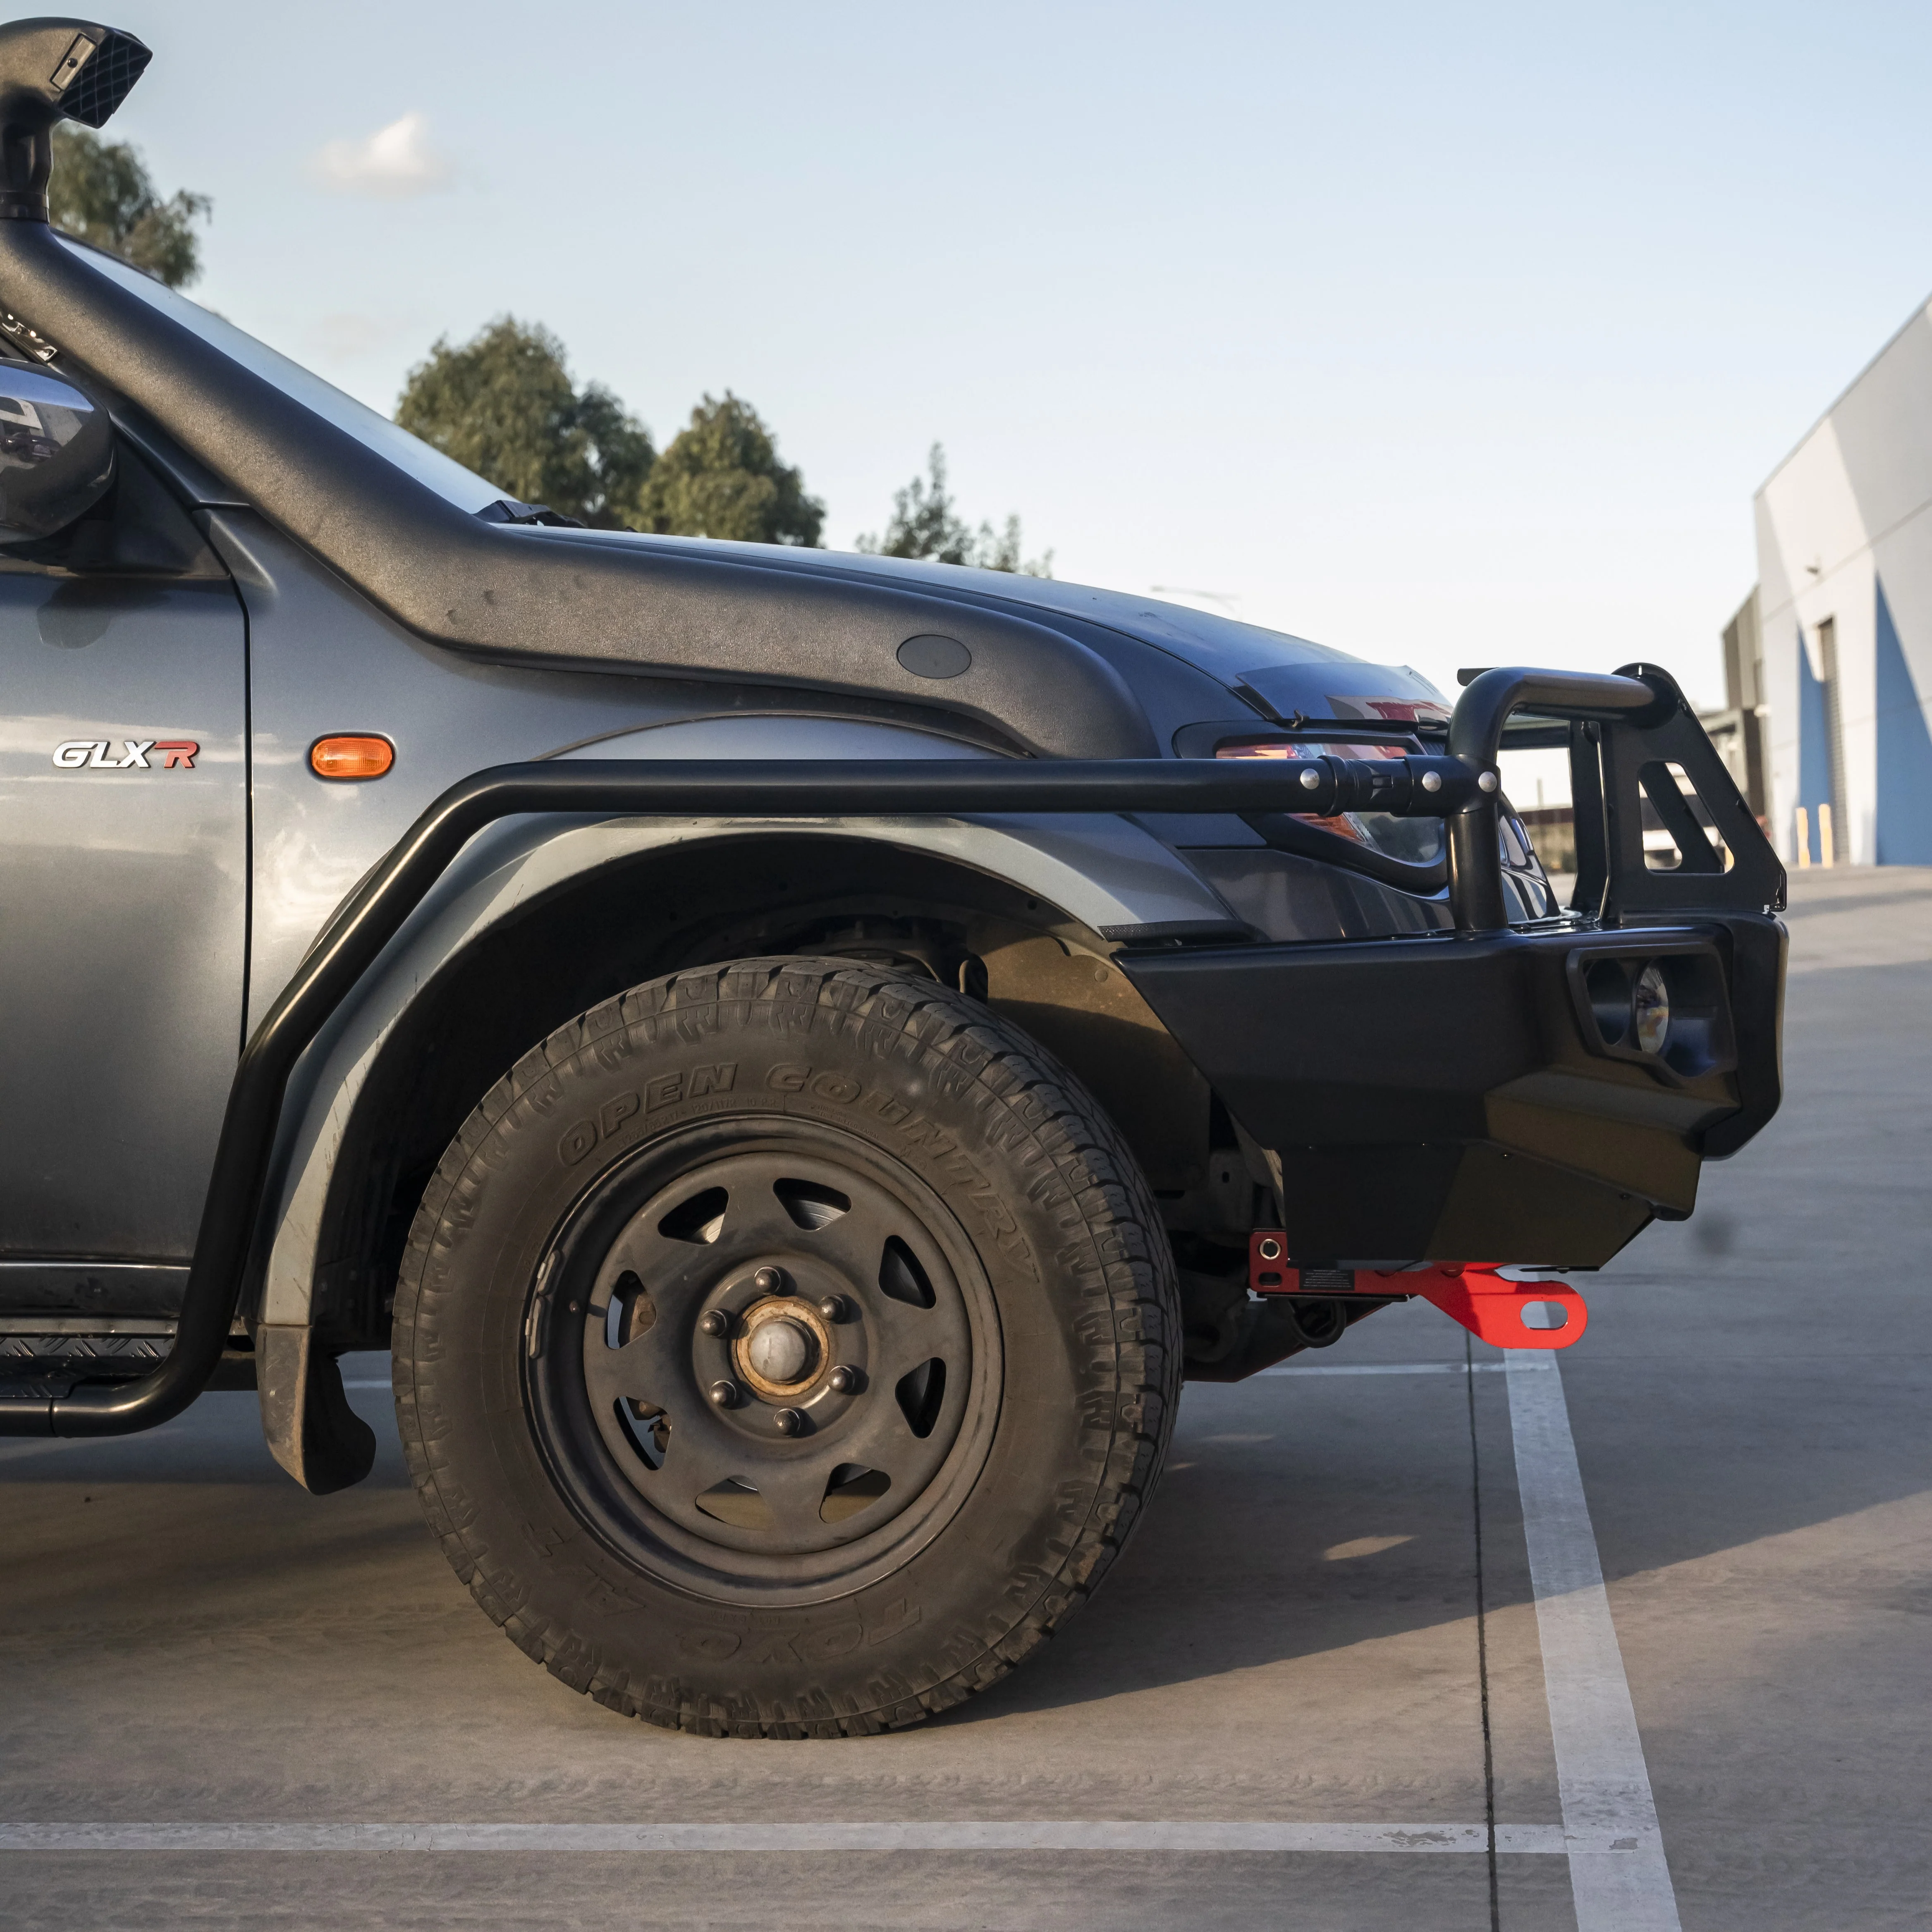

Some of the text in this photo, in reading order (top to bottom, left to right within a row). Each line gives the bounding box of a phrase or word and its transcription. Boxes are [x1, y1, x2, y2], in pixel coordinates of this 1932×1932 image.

[558, 1063, 1041, 1284] OPEN COUNTRY
[677, 1597, 921, 1664] TOYO
